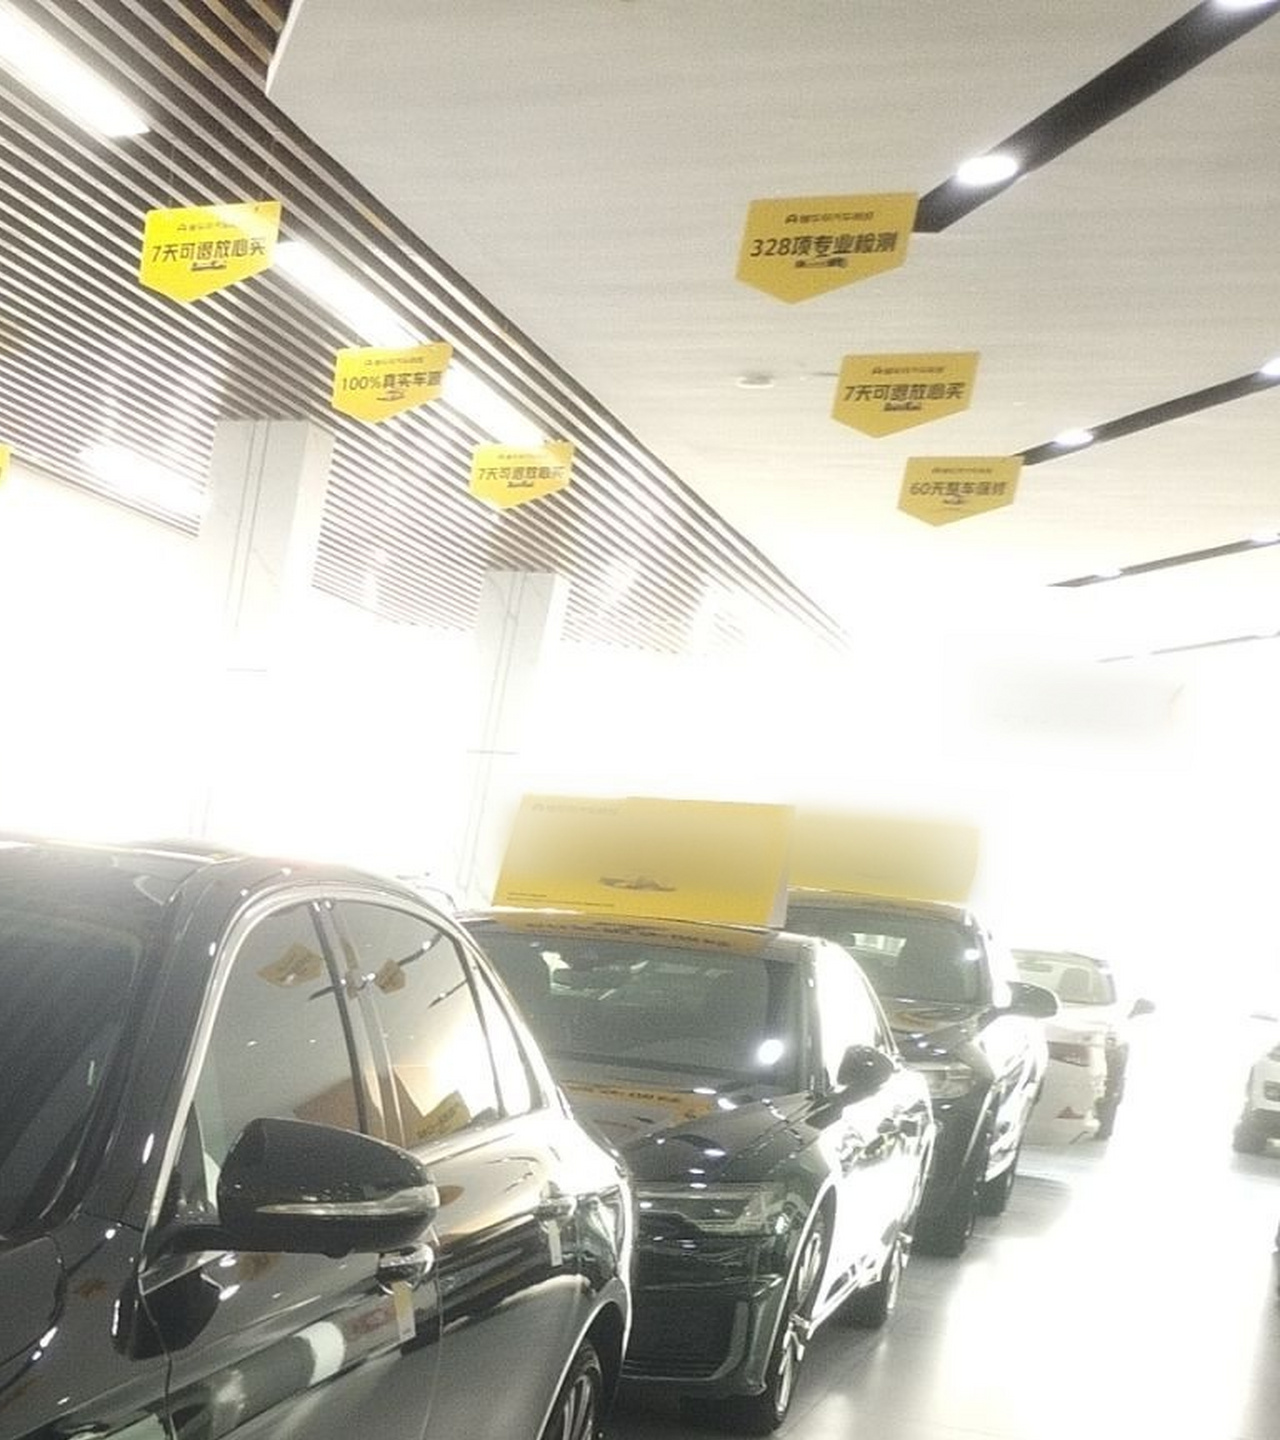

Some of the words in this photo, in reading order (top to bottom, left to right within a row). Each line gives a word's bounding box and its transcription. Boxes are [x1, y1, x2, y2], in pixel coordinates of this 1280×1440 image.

[151, 238, 267, 262] 7天可退放心买
[750, 231, 898, 257] 328项专业检测
